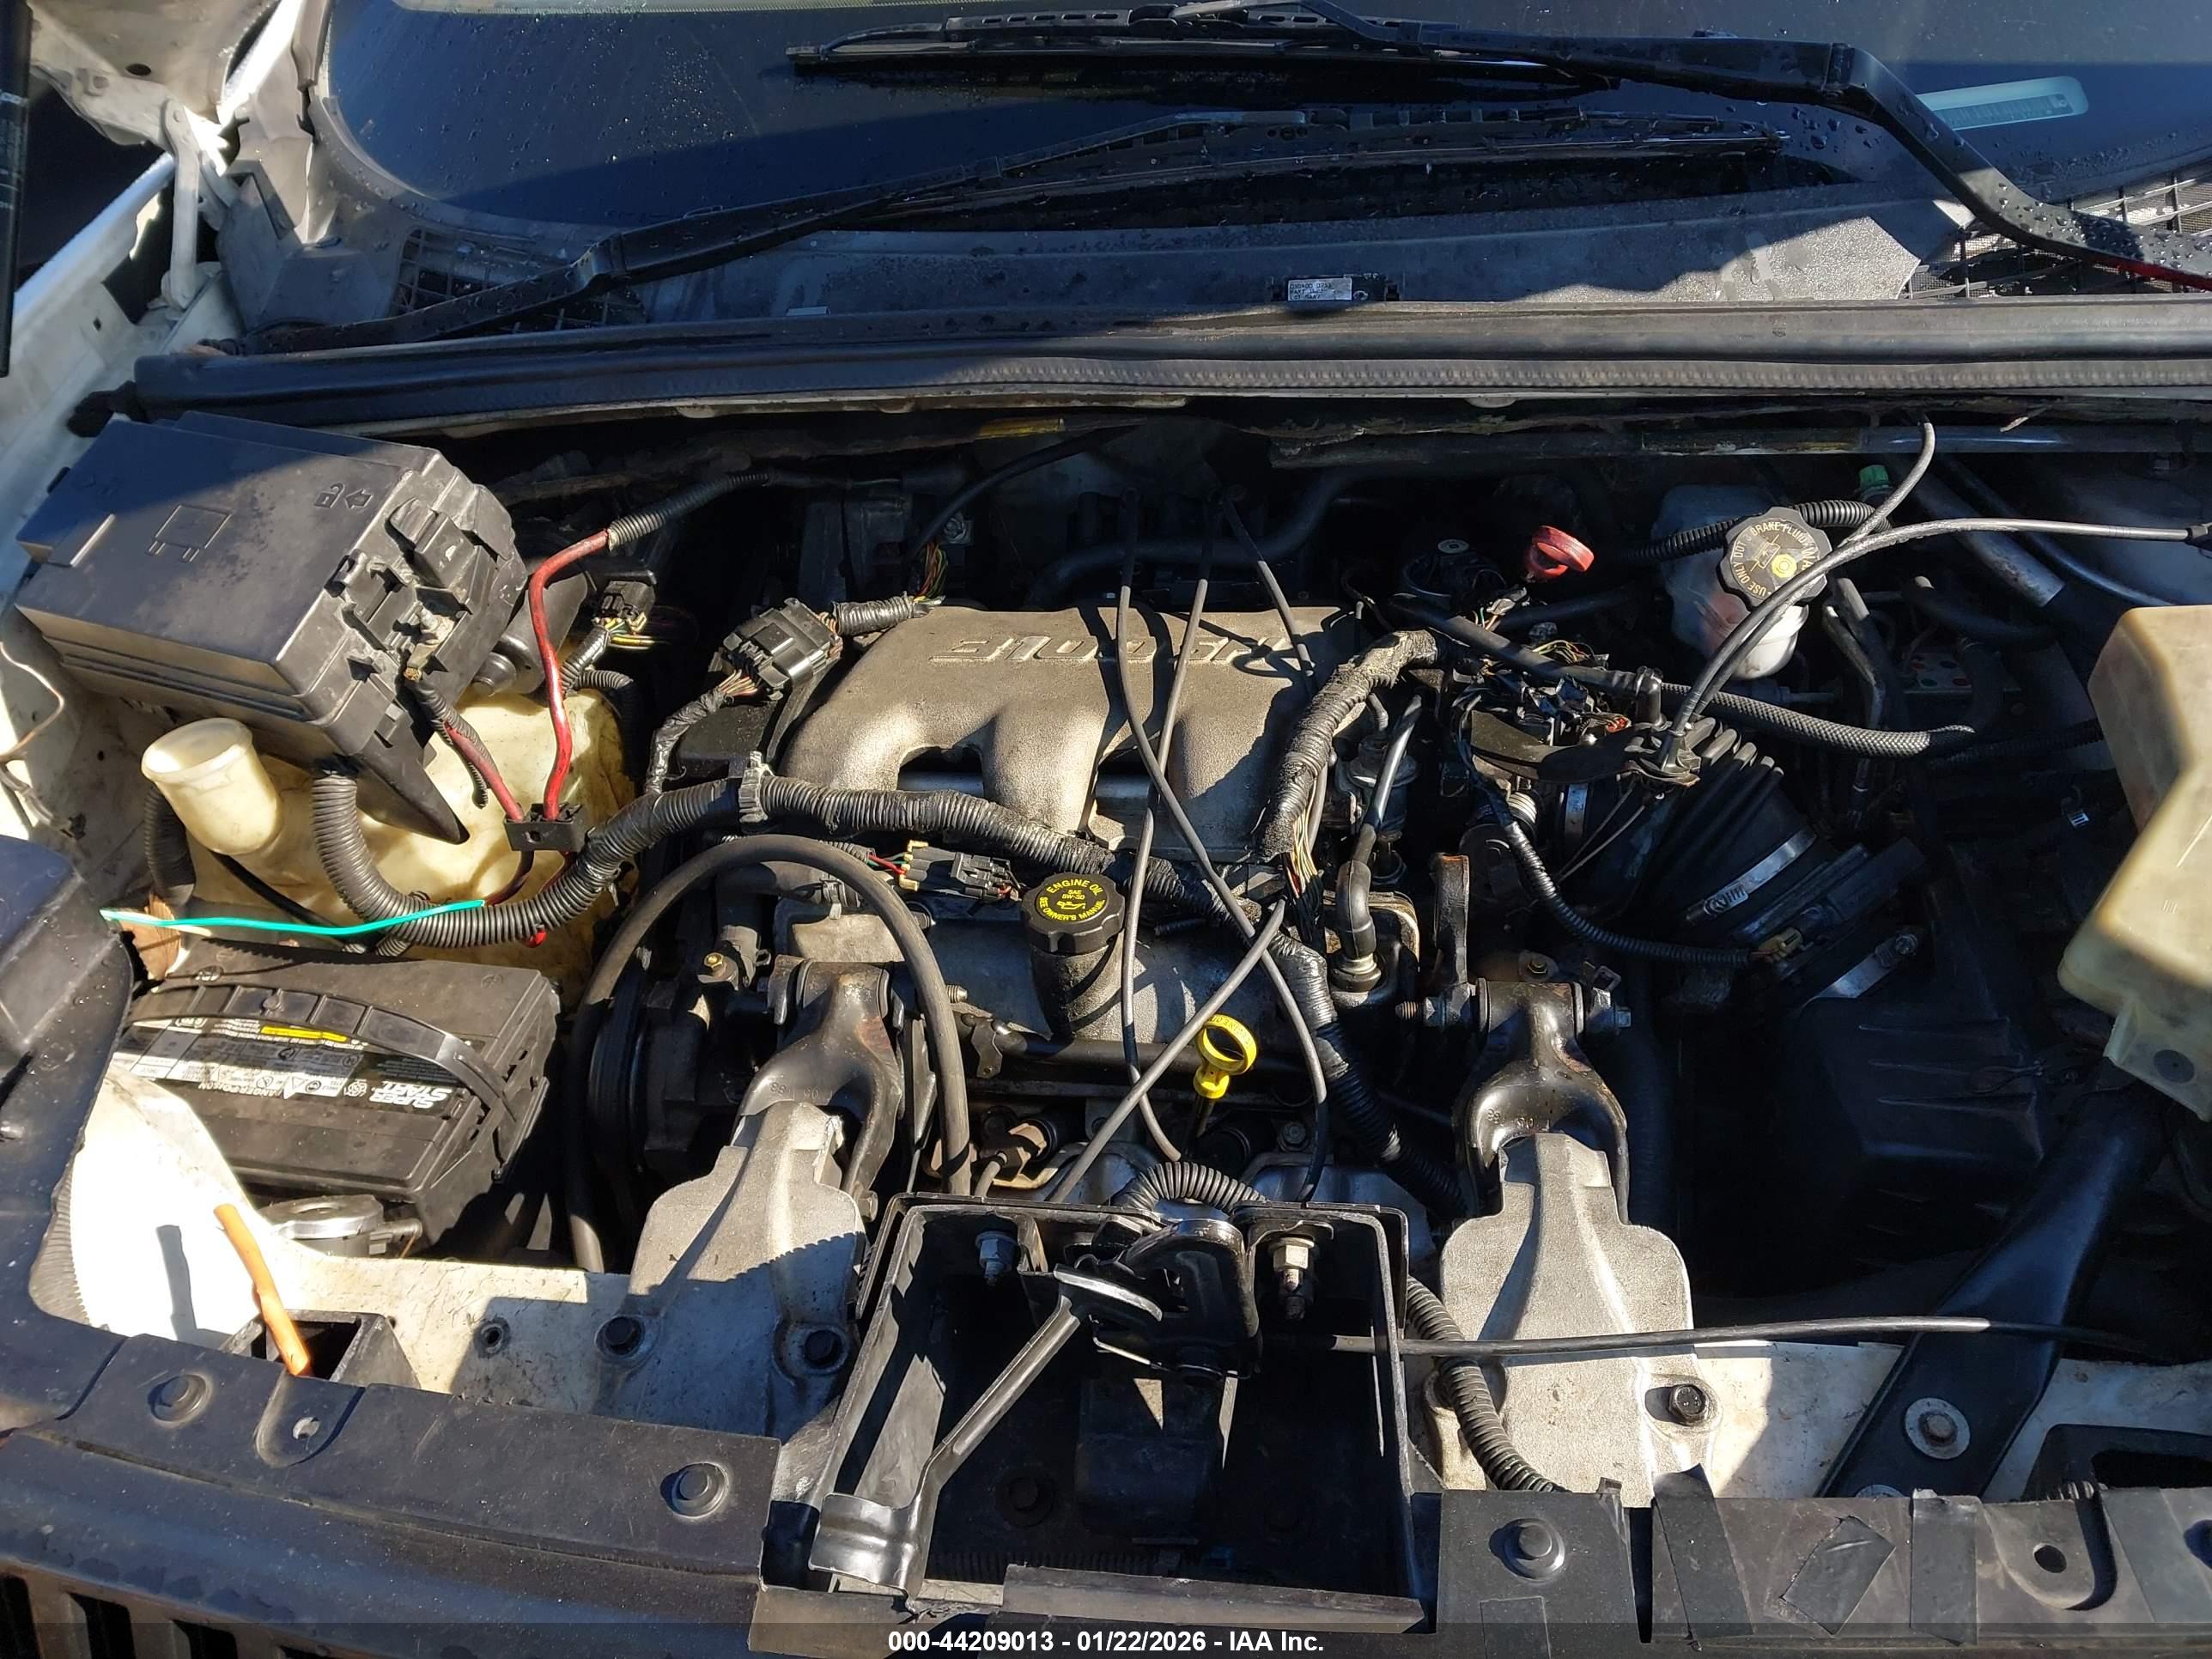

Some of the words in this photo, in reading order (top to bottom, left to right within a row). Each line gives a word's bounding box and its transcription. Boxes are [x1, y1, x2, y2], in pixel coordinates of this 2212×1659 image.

[1750, 521, 1780, 536] BRAKE
[1782, 525, 1808, 544] FLUID
[1735, 541, 1747, 558] DOT
[1733, 562, 1751, 584] ONLY
[1747, 581, 1767, 597] USE
[1046, 878, 1091, 894] ENGINE
[1089, 883, 1103, 896] OIL
[1039, 896, 1048, 908] SEE
[1078, 899, 1106, 920] MANUAL
[1042, 908, 1077, 921] OWNER'S
[379, 1081, 453, 1102] START
[369, 1093, 434, 1109] SUPER
